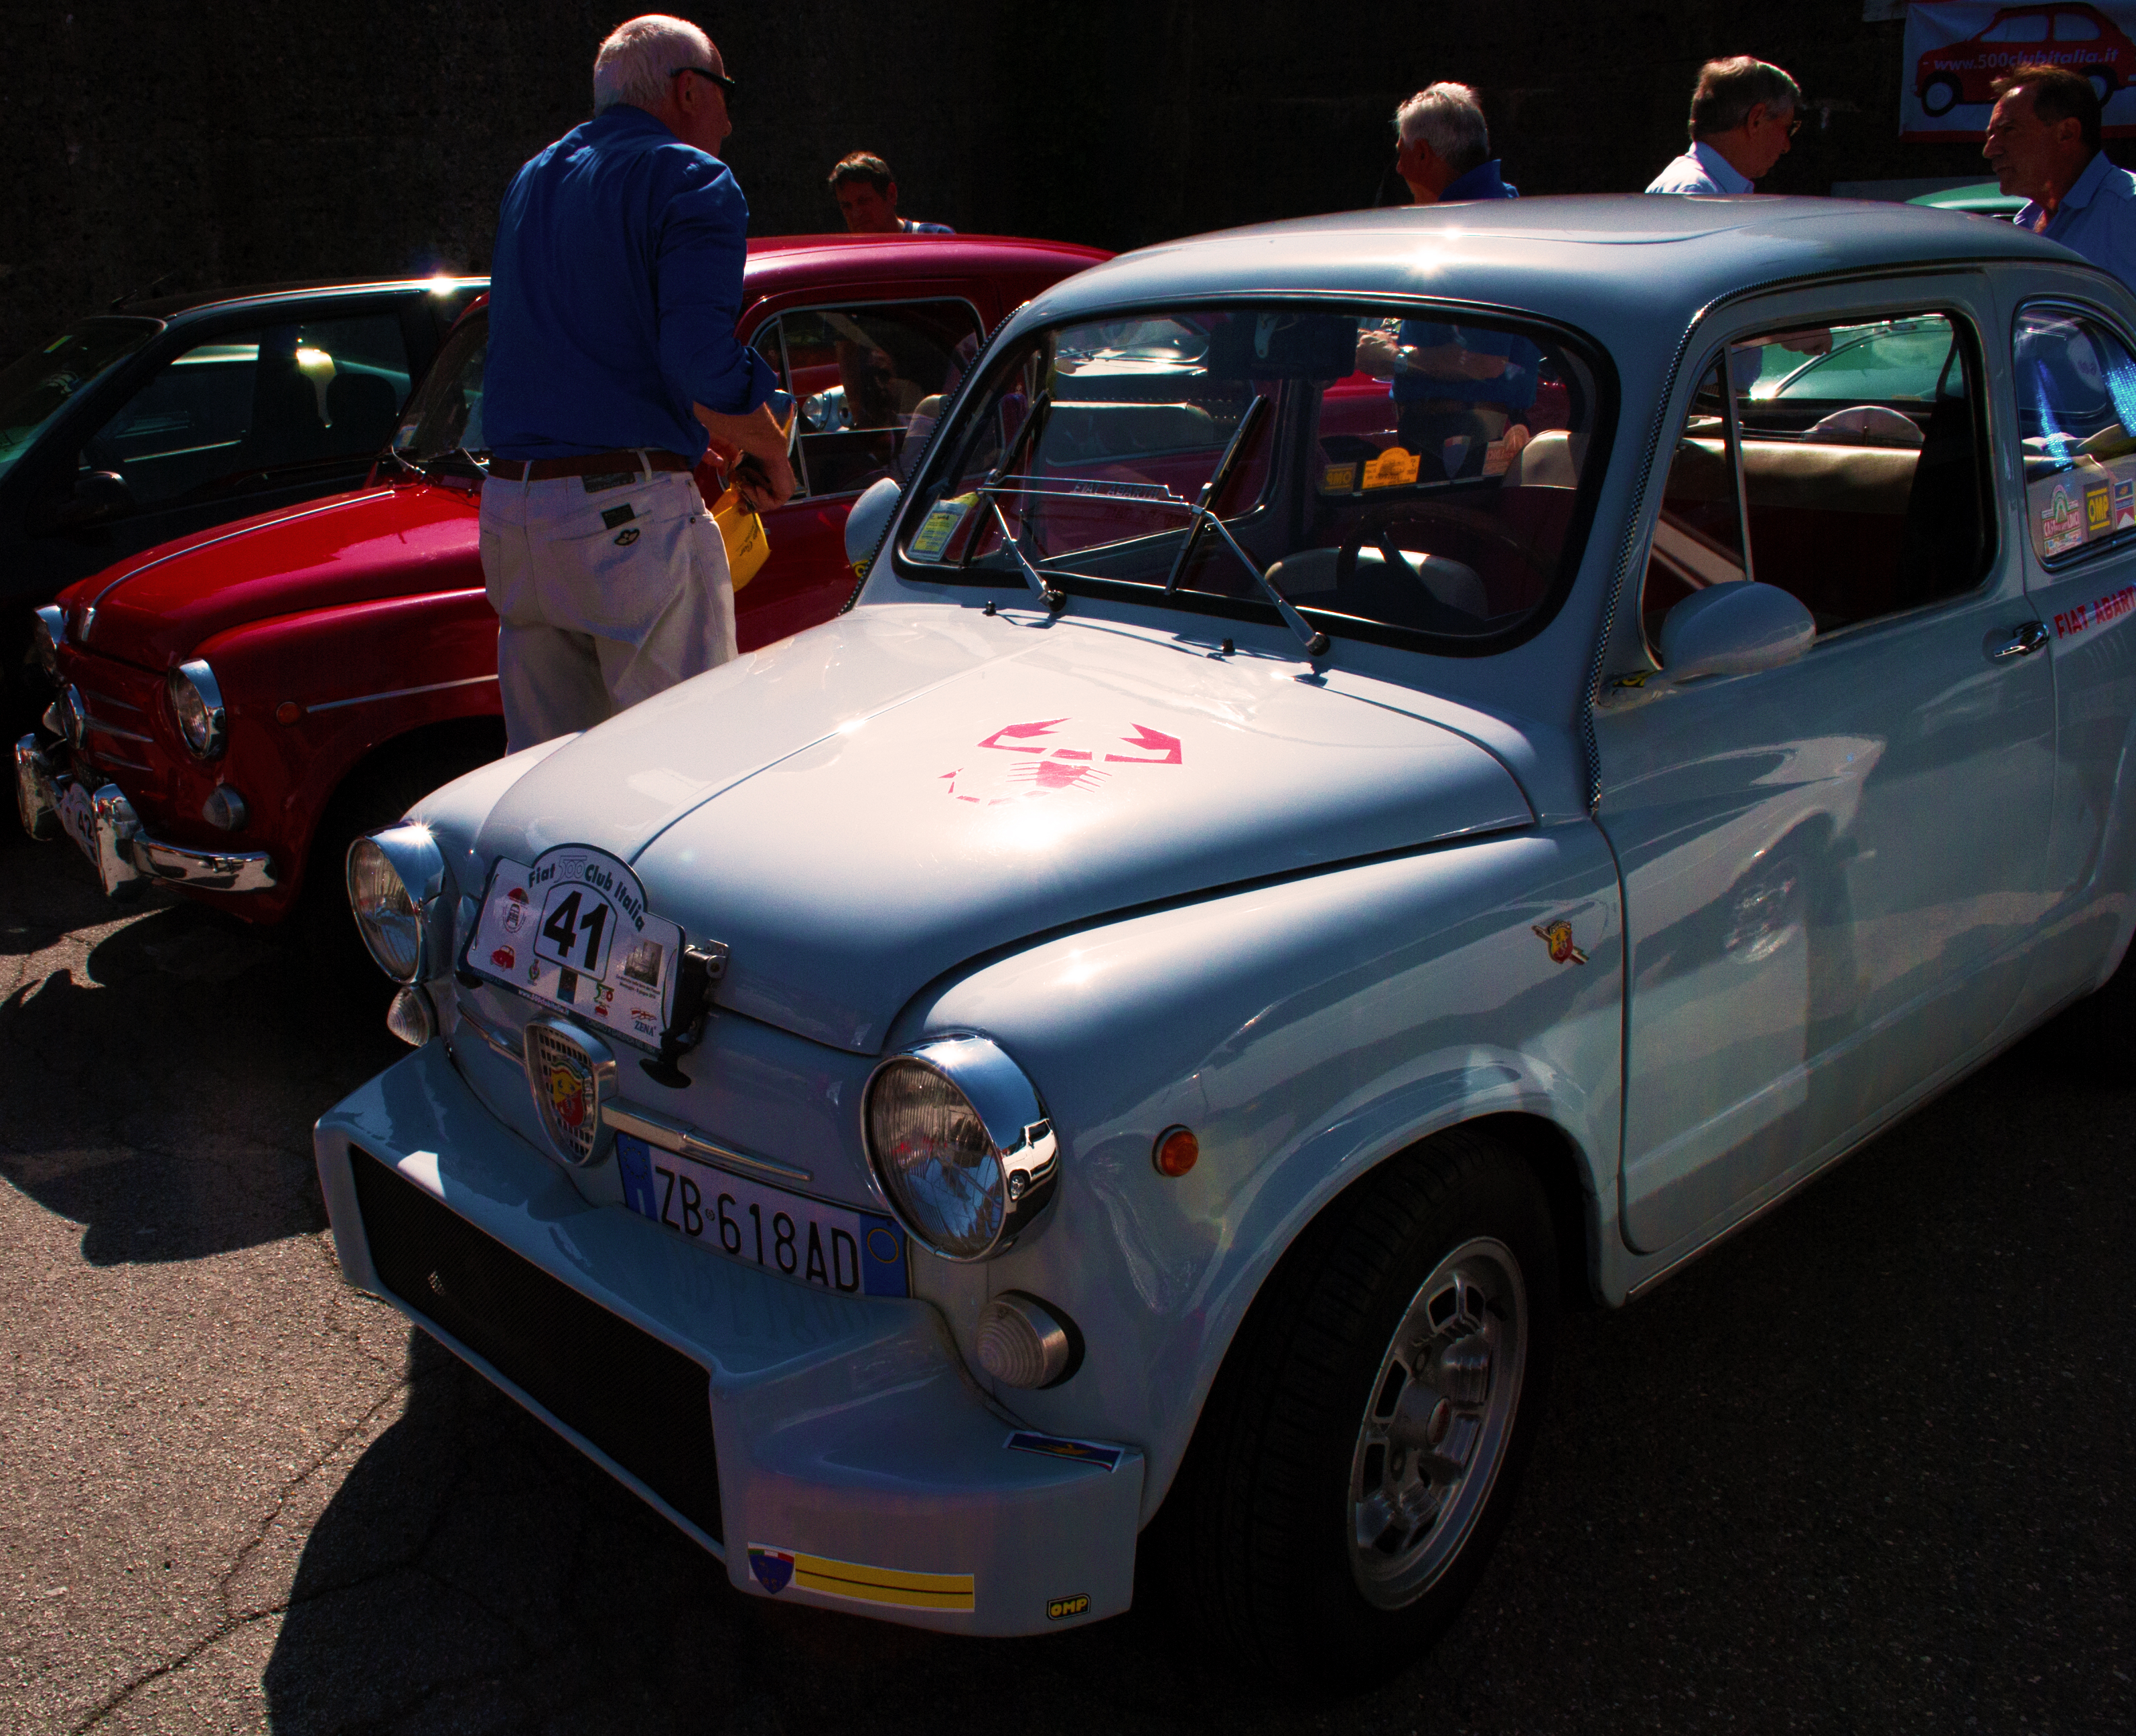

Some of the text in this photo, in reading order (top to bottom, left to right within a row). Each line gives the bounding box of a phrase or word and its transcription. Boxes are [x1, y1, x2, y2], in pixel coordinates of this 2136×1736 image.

[1934, 48, 2119, 70] www.500clubitalia.it
[1073, 481, 1160, 501] FIAT ABARTH
[2088, 495, 2110, 523] OMP
[2054, 604, 2090, 640] FIAT
[528, 863, 556, 889] Fiat
[584, 864, 614, 891] Club
[614, 881, 645, 932] Italia
[543, 890, 609, 971] 41
[1050, 1597, 1088, 1617] OMP
